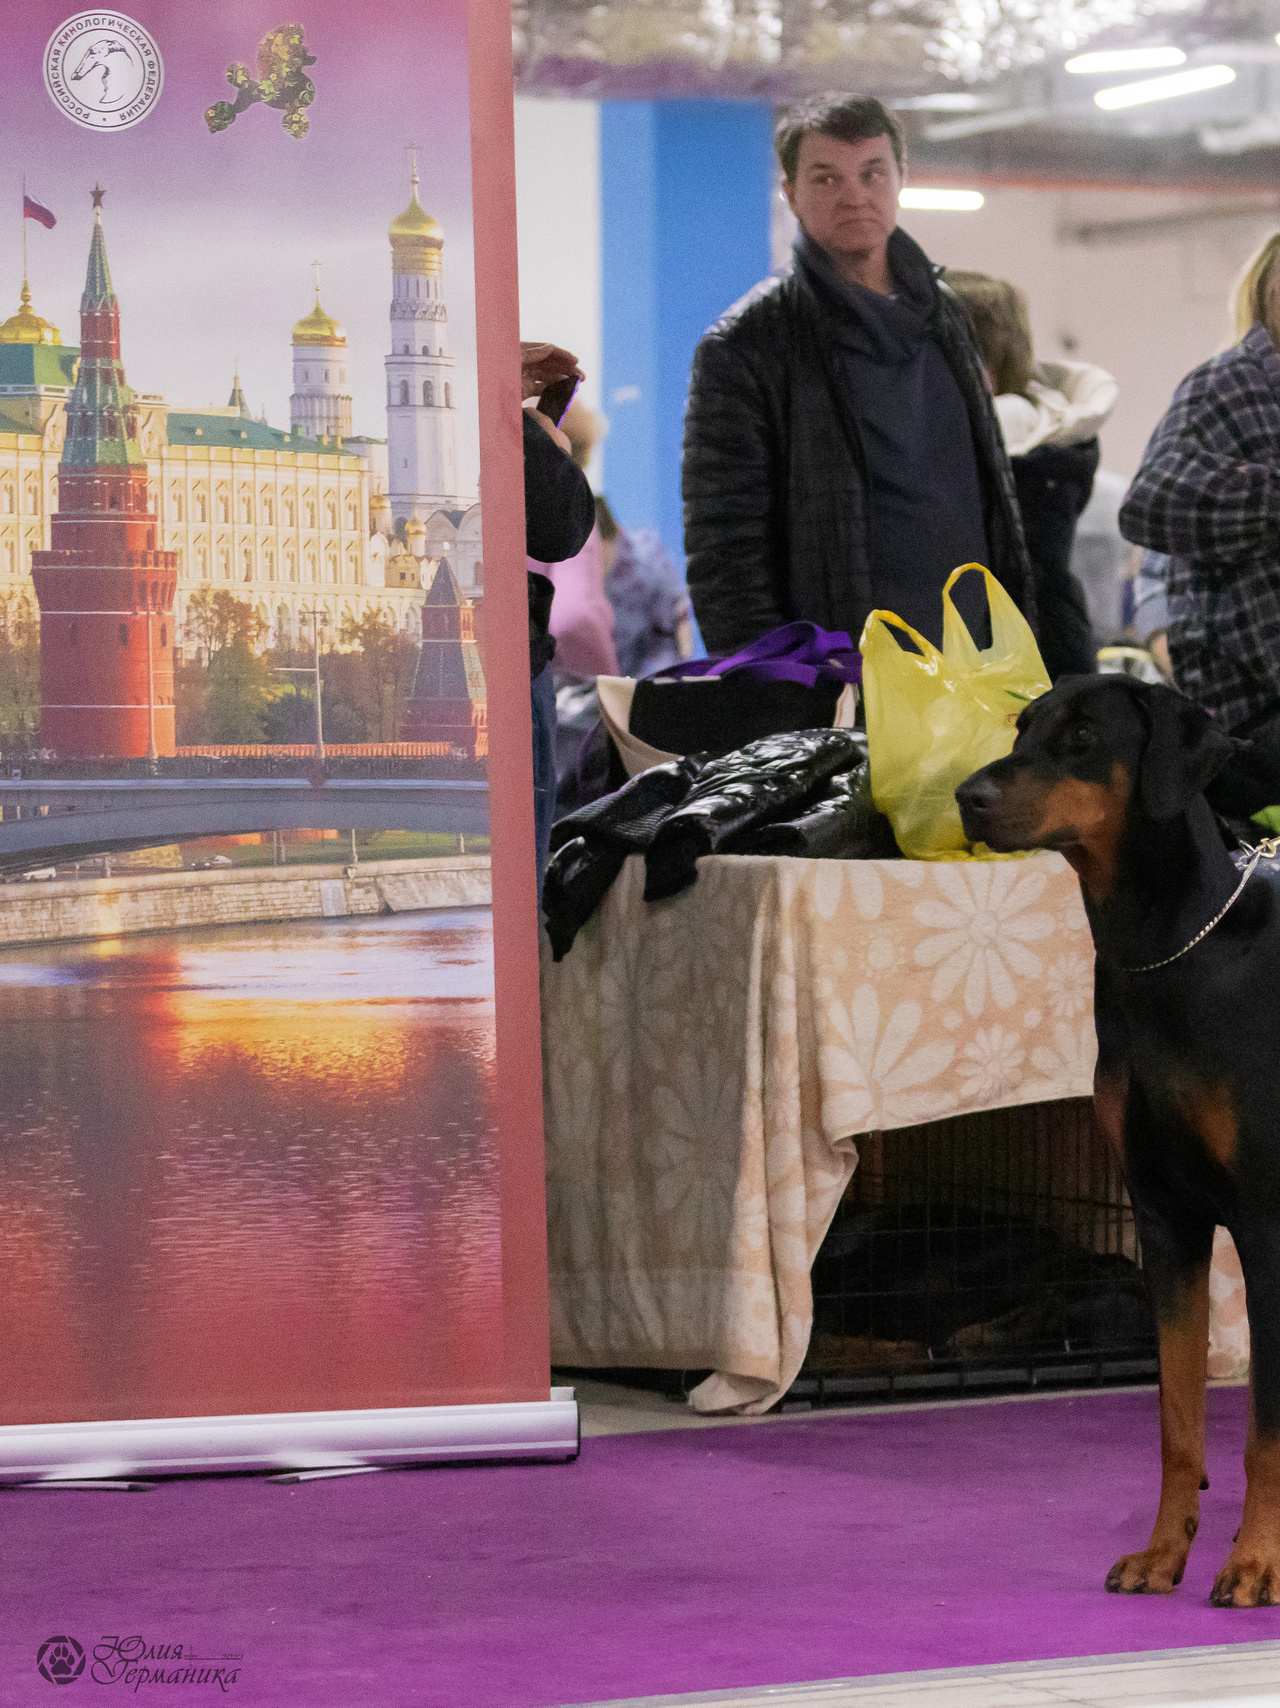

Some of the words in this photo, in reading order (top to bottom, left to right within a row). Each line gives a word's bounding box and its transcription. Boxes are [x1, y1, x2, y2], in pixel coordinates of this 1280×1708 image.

[58, 17, 152, 57] КИНОЛОГИЧЕСКАЯ
[51, 49, 90, 119] РОССИЙСКАЯ
[119, 60, 157, 121] ФЕДЕРАЦИЯ
